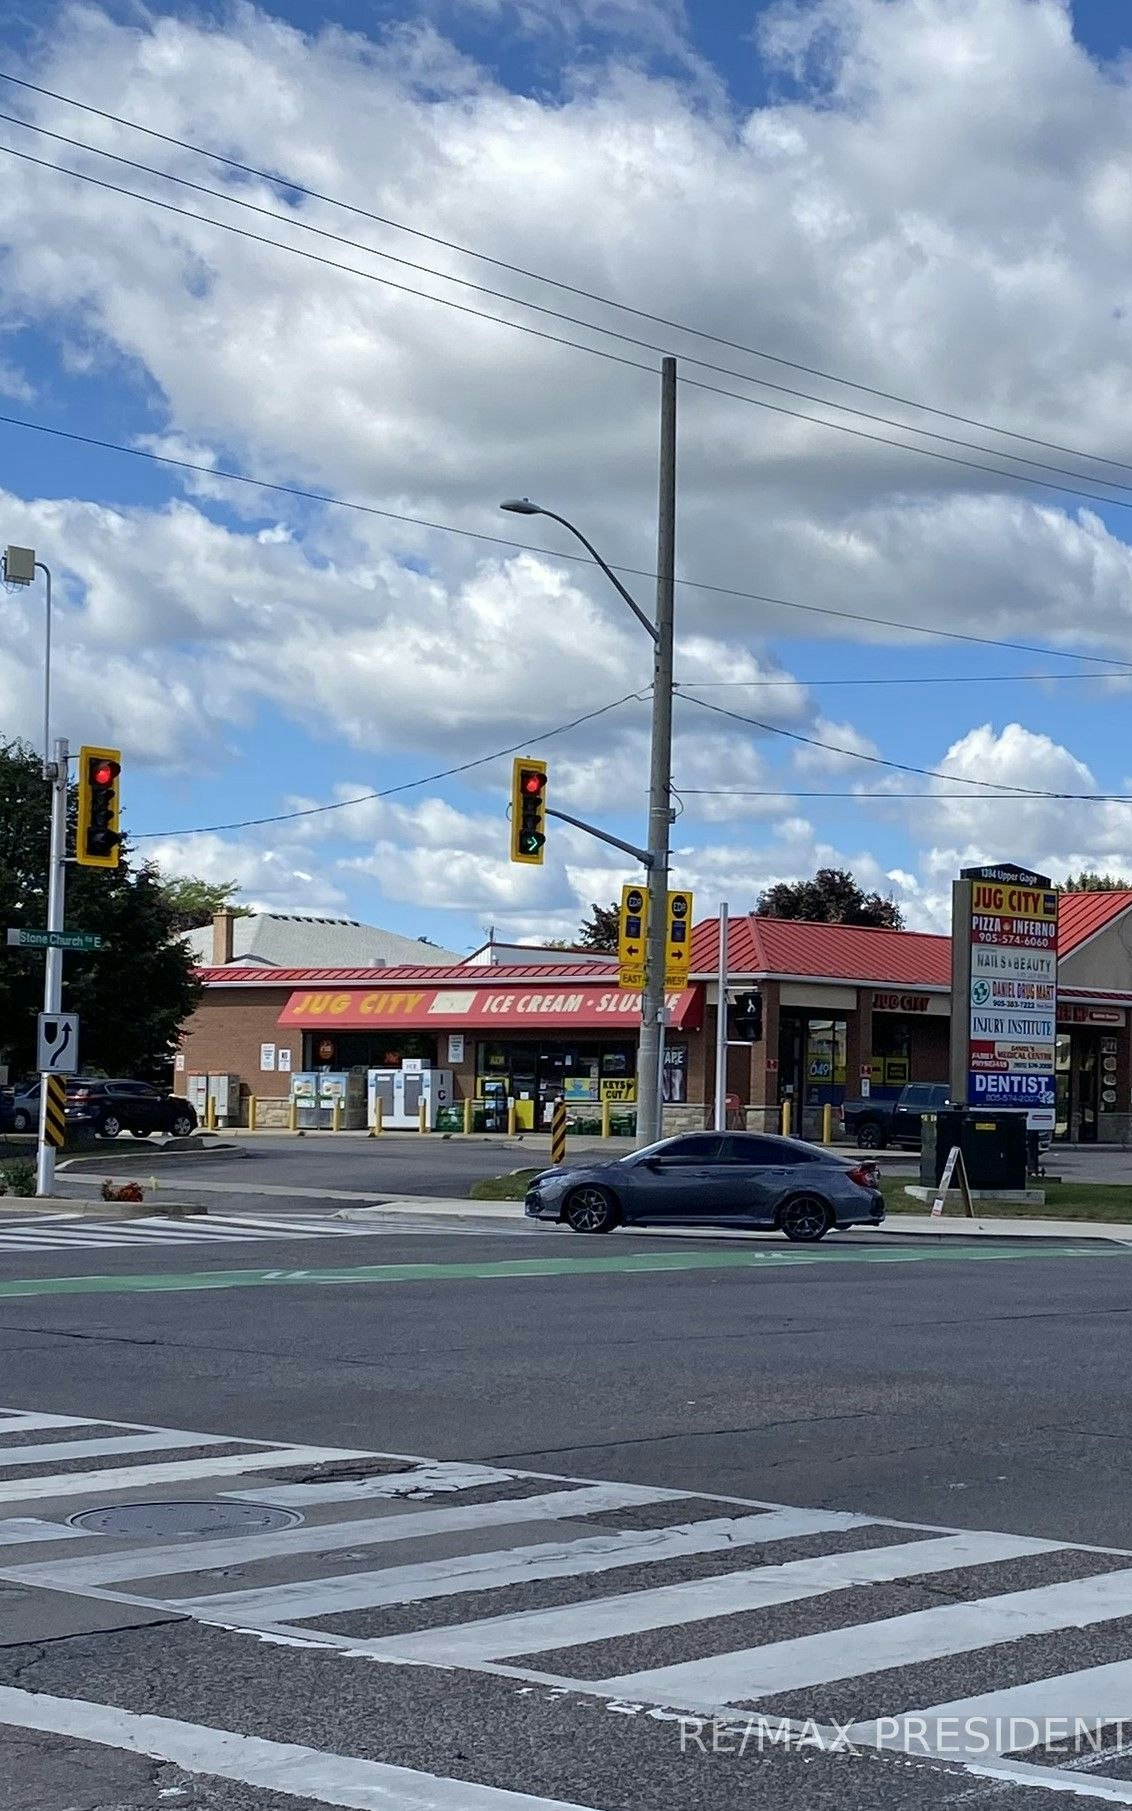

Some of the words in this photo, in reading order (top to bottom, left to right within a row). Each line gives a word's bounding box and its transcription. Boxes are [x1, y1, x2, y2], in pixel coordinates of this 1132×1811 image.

[998, 870, 1018, 882] Upper
[1020, 872, 1037, 885] Gage
[974, 887, 1004, 910] JUG
[1008, 890, 1041, 913] CITY
[972, 916, 1001, 932] PIZZA
[1013, 920, 1055, 937] INFERNO
[20, 931, 48, 944] Stone
[49, 934, 83, 947] Church
[94, 937, 101, 948] E
[979, 933, 1049, 947] 905-574-6060
[977, 954, 1006, 968] NAILS
[1014, 957, 1051, 972] BEAUTY
[622, 974, 642, 984] EAST
[993, 981, 1015, 998] DANIEL
[1017, 982, 1034, 999] DRUG
[1036, 984, 1054, 1000] MART
[293, 994, 352, 1016] JUG
[359, 993, 427, 1015] CITY
[481, 995, 515, 1013] ICE
[516, 994, 584, 1013] CREAM
[595, 993, 682, 1013] SLUSE
[873, 993, 899, 1010] JUG
[973, 1017, 1005, 1034] INJURY
[1008, 1019, 1052, 1036] INSTITUTE
[664, 1051, 684, 1065] APE
[602, 1080, 625, 1090] KEYS
[975, 1074, 1049, 1093] DENTIST
[606, 1090, 623, 1100] CUT
